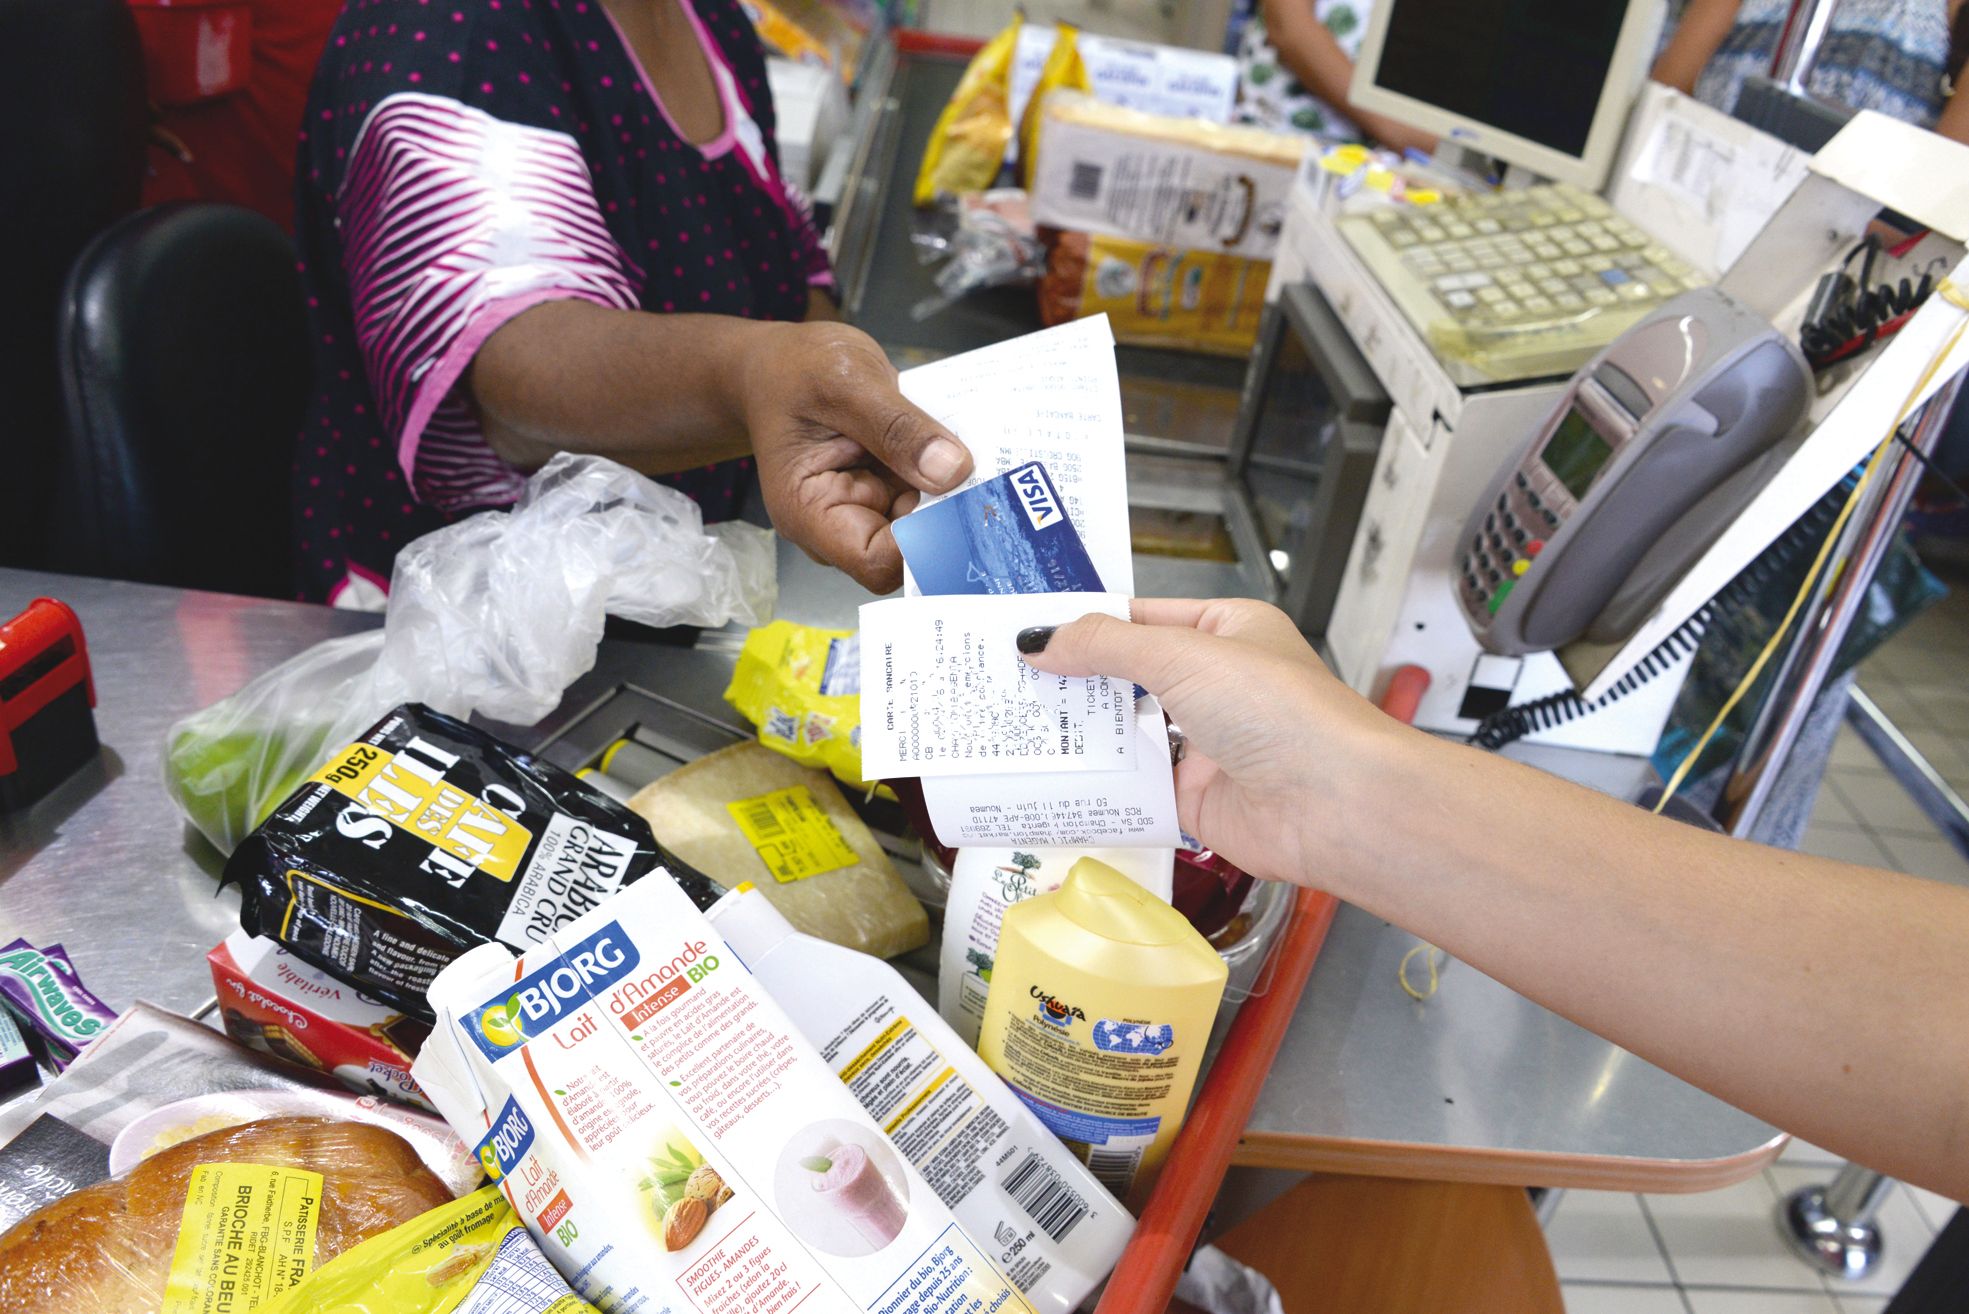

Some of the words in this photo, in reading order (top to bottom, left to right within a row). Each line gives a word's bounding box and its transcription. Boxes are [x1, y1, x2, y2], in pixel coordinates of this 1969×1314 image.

[1018, 469, 1054, 526] VISA
[334, 746, 378, 783] 250g
[414, 790, 459, 837] DES
[970, 805, 1001, 813] Noumea
[539, 830, 561, 859] 100%
[548, 826, 589, 896] GRAND
[512, 862, 546, 915] ARABICA
[552, 834, 625, 939] ARABIC
[526, 899, 557, 944] CRU
[382, 933, 398, 944] fine
[399, 941, 416, 951] and
[417, 947, 449, 962] delicate
[276, 962, 343, 1000] Véritable
[394, 955, 437, 981] packaging
[523, 938, 626, 1021] BJORG
[610, 942, 711, 1018] d'Amande
[0, 949, 105, 1040] Airwaves
[631, 987, 685, 1023] Intense
[686, 956, 719, 983] BIO
[656, 1016, 670, 1027] fois
[671, 987, 706, 1019] gourmand
[641, 1043, 649, 1051] et
[649, 1027, 673, 1047] pauvre
[673, 1016, 683, 1028] en
[683, 1003, 705, 1020] acides
[705, 991, 720, 1005] gras
[662, 1037, 693, 1062] complice
[694, 1030, 703, 1038] de
[702, 995, 749, 1031] l'alimentation
[681, 1023, 695, 1035] Lait
[695, 996, 730, 1024] d'Amande
[730, 987, 742, 997] est
[1033, 1015, 1069, 1037] Polynésie
[553, 1013, 597, 1049] Lait
[661, 1065, 674, 1076] des
[674, 1050, 694, 1068] petits
[694, 1030, 720, 1051] comme
[720, 1020, 733, 1031] des
[733, 1002, 758, 1023] grands.
[678, 1086, 692, 1096] vos
[692, 1053, 733, 1089] préparations
[733, 1029, 767, 1054] culinaires,
[680, 1057, 712, 1082] Excellent
[712, 1031, 745, 1060] partenaire
[746, 1023, 755, 1031] de
[685, 1091, 702, 1104] vous
[703, 1071, 728, 1094] pouvez
[733, 1051, 753, 1067] boire
[753, 1032, 774, 1051] chaud
[693, 1104, 703, 1113] ou
[702, 1089, 722, 1105] froid,
[722, 1076, 739, 1090] dans
[738, 1061, 757, 1076] votre
[756, 1051, 771, 1062] thé,
[771, 1035, 789, 1050] votre
[700, 1106, 717, 1121] café,
[717, 1098, 727, 1107] ou
[727, 1080, 751, 1099] encore
[749, 1058, 776, 1080] l'utiliser
[777, 1045, 793, 1059] dans
[706, 1118, 719, 1129] vos
[720, 1097, 746, 1119] recettes
[746, 1077, 771, 1098] sucrées
[770, 1057, 797, 1078] (crêpes,
[883, 1078, 896, 1091] plein
[494, 1107, 529, 1161] BJORG
[578, 1115, 602, 1134] origine
[589, 1139, 604, 1151] leur
[605, 1126, 622, 1143] goût
[714, 1114, 744, 1139] gâteaux,
[520, 1154, 543, 1186] Lait
[526, 1168, 559, 1213] d'Amande
[215, 1207, 230, 1246] GARANTIE
[227, 1186, 252, 1250] BRIOCHE
[294, 1197, 314, 1254] PATISSERIE
[438, 1240, 449, 1249] au
[464, 1213, 494, 1234] fromage
[465, 1208, 483, 1222] base
[543, 1199, 567, 1227] Intense
[248, 1232, 258, 1252] RIDET
[550, 1220, 578, 1247] BIO
[1010, 1238, 1026, 1256] 250
[1026, 1231, 1035, 1241] ml
[210, 1249, 221, 1271] SANS
[223, 1254, 239, 1275] AU
[687, 1249, 725, 1287] SMOOTHIE
[723, 1236, 759, 1271] AMANDES
[910, 1278, 921, 1290] du
[918, 1266, 935, 1279] bio,
[931, 1246, 953, 1266] Bjorg
[288, 1259, 305, 1289] FRA
[704, 1287, 726, 1307] Mixez
[726, 1280, 732, 1288] 2
[733, 1272, 743, 1282] ou
[743, 1265, 749, 1273] 3
[749, 1247, 771, 1267] figues
[740, 1271, 762, 1292] (selon
[760, 1264, 770, 1272] la
[745, 1279, 771, 1304] ajoutez
[919, 1277, 942, 1302] depuis
[940, 1266, 951, 1279] 25
[950, 1256, 962, 1270] ans
[753, 1280, 789, 1314] d'Amande.
[766, 1300, 783, 1314] bien
[781, 1287, 797, 1302] frais
[969, 1299, 982, 1311] les
[990, 1289, 1010, 1313] choisis
